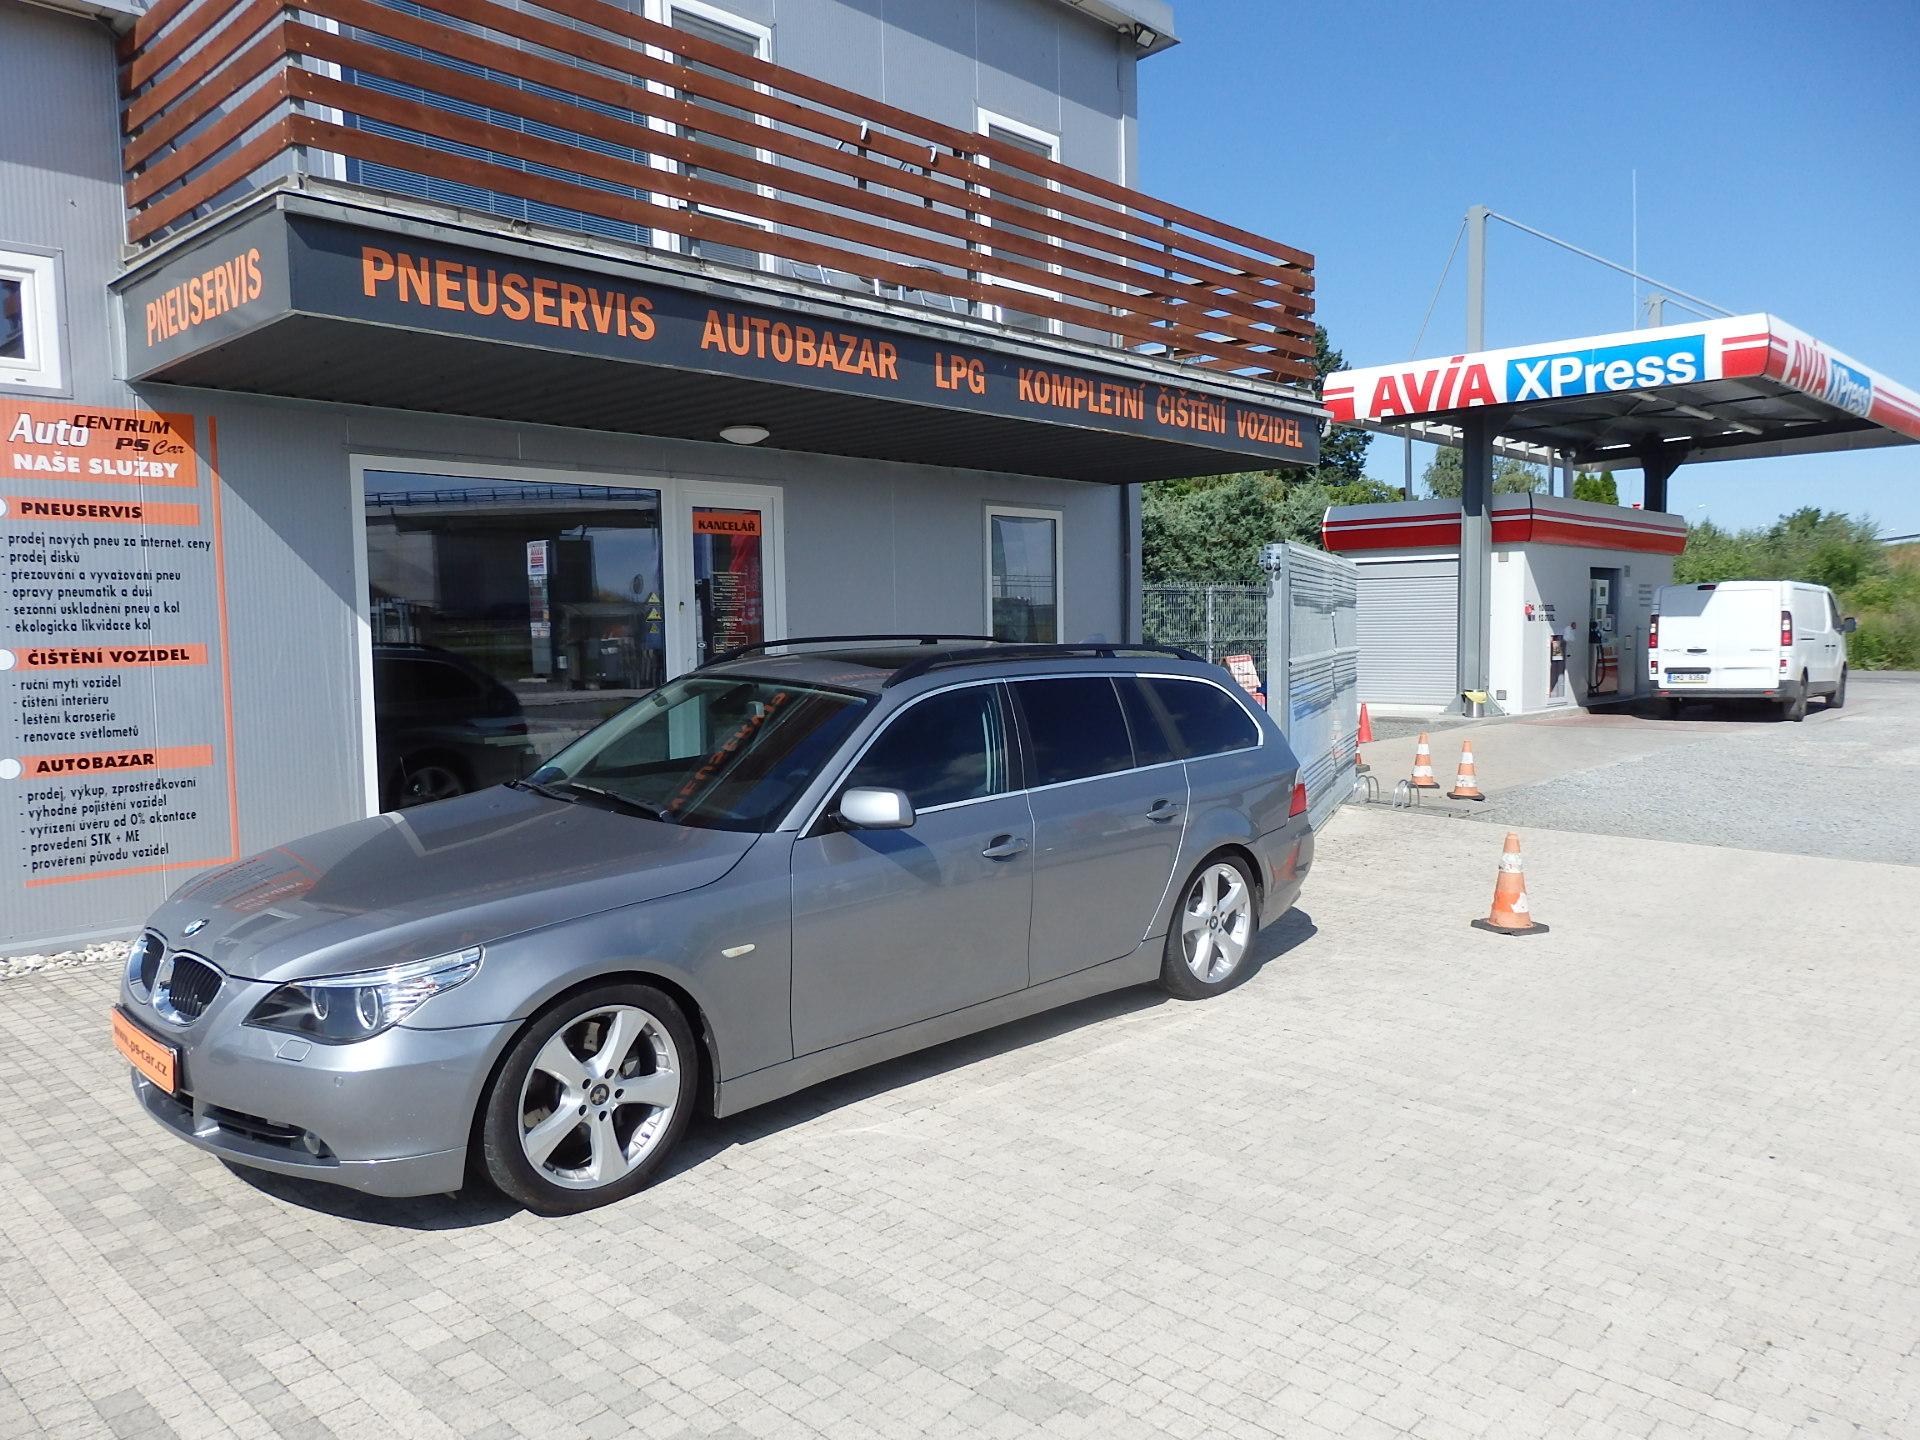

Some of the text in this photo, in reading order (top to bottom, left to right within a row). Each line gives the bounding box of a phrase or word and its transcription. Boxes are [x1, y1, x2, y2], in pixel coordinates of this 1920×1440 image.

[146, 247, 262, 347] PNEUSERVIS
[361, 246, 1304, 449] PNEUSERVIS AUTOBAZAR LPG KOMPLETNÍ ČIŠTĚNÍ VOZIDEL
[1513, 350, 1698, 404] XPress
[7, 412, 171, 447] Auto CENTRUM
[115, 437, 185, 455] PS Car
[13, 450, 180, 479] NAŠE SLUŽBY
[20, 501, 143, 518] PNEUSERVIS
[698, 519, 756, 533] KANCELÁŘ
[8, 532, 46, 548] prodej
[49, 533, 90, 549] nových
[93, 536, 120, 549] pneu
[123, 538, 137, 547] za
[187, 540, 212, 552] ceny
[9, 549, 47, 566] prodej
[79, 571, 86, 580] a
[156, 571, 181, 583] pneu
[12, 588, 53, 601] opravy
[57, 584, 117, 601] pneumatik
[121, 588, 128, 597] a
[124, 604, 150, 617] pneu
[153, 604, 160, 614] a
[163, 600, 180, 614] kol
[81, 617, 132, 632] likvidace
[134, 617, 151, 631] kol
[28, 648, 190, 665] ČIŠTĚNÍ VOZIDEL
[82, 674, 121, 688] vozidel
[64, 708, 116, 723] karoserie
[23, 730, 76, 743] renovace
[36, 753, 154, 773] AUTOBAZAR
[130, 793, 167, 809] vozidel
[113, 813, 127, 827] od
[130, 811, 146, 826] 0%
[149, 810, 197, 824] akontace
[30, 835, 87, 857] provedení
[90, 831, 112, 847] STK
[125, 828, 141, 843] ME
[132, 842, 169, 859] vozidel
